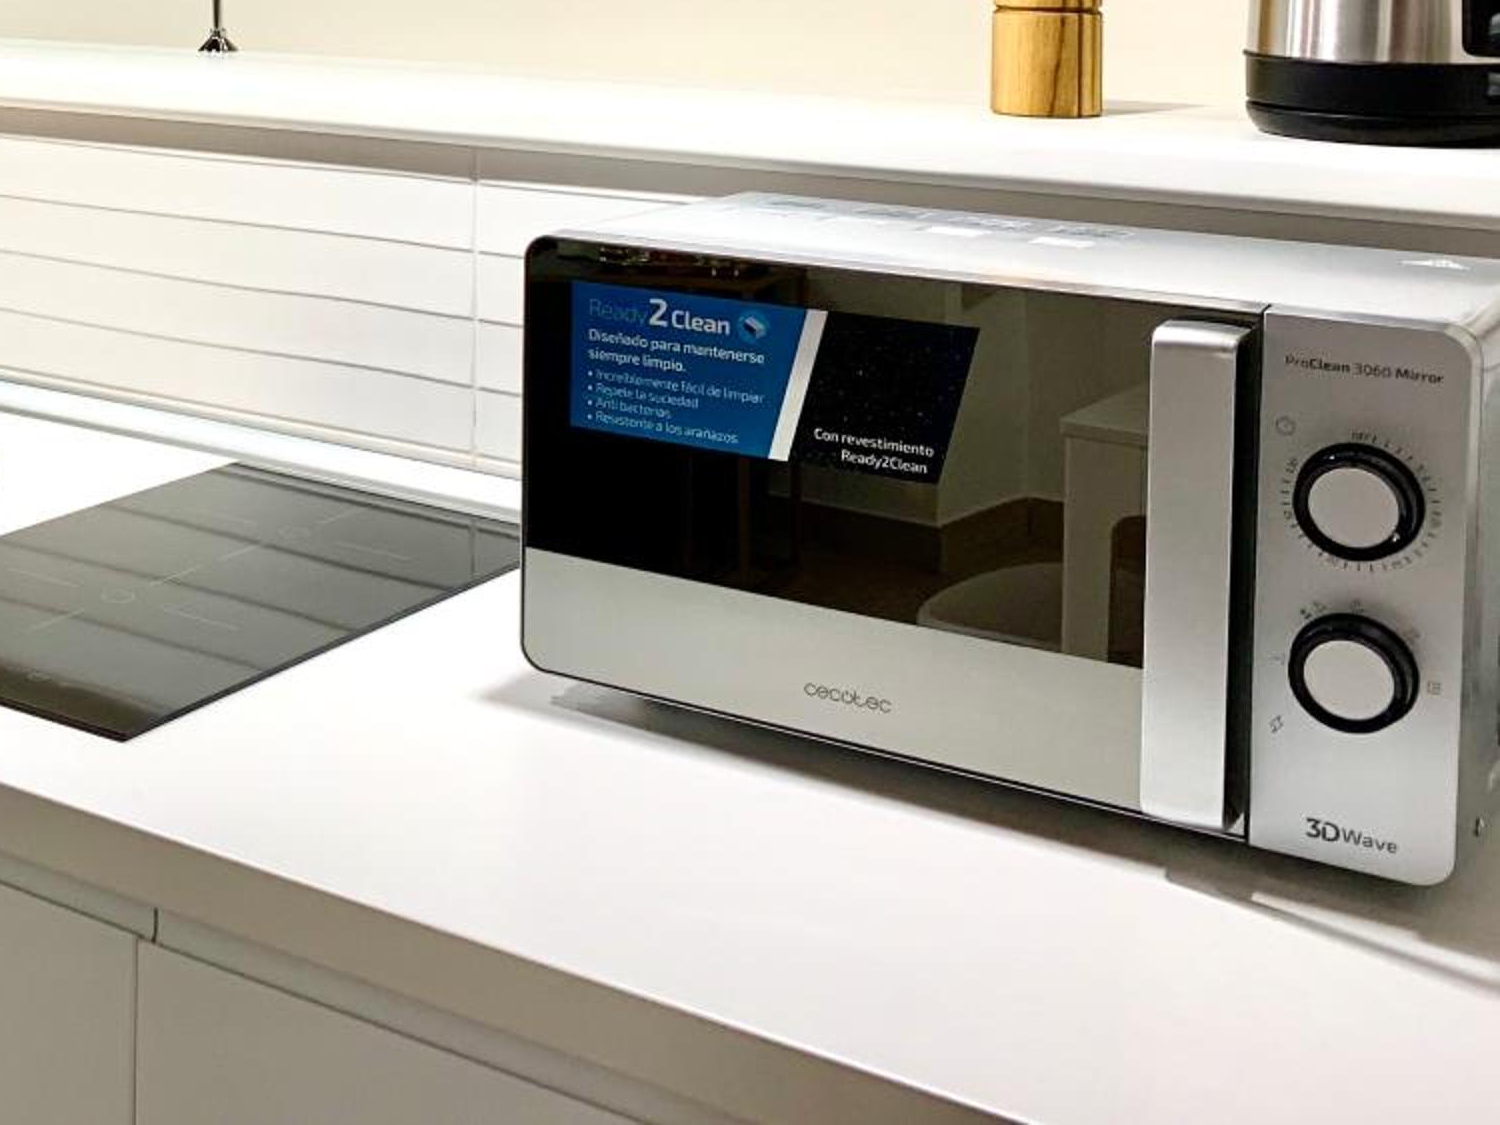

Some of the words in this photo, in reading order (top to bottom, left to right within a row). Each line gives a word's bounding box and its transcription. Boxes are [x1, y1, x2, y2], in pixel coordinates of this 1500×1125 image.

[671, 310, 731, 336] Clean
[589, 328, 648, 348] Diseñado
[651, 340, 681, 353] para
[683, 342, 765, 364] mantenerse
[588, 347, 640, 367] siempre
[642, 353, 686, 373] limpio.
[1285, 354, 1350, 374] ProClean
[1354, 362, 1391, 378] 3060
[1395, 367, 1444, 384] Mirror
[706, 385, 722, 398] de
[724, 386, 766, 405] limpiar
[656, 421, 664, 432] a
[665, 423, 682, 436] los
[813, 427, 839, 442] Con
[841, 434, 935, 458] revestimiento
[841, 448, 928, 474] Ready2Clean
[804, 682, 892, 714] cecotec
